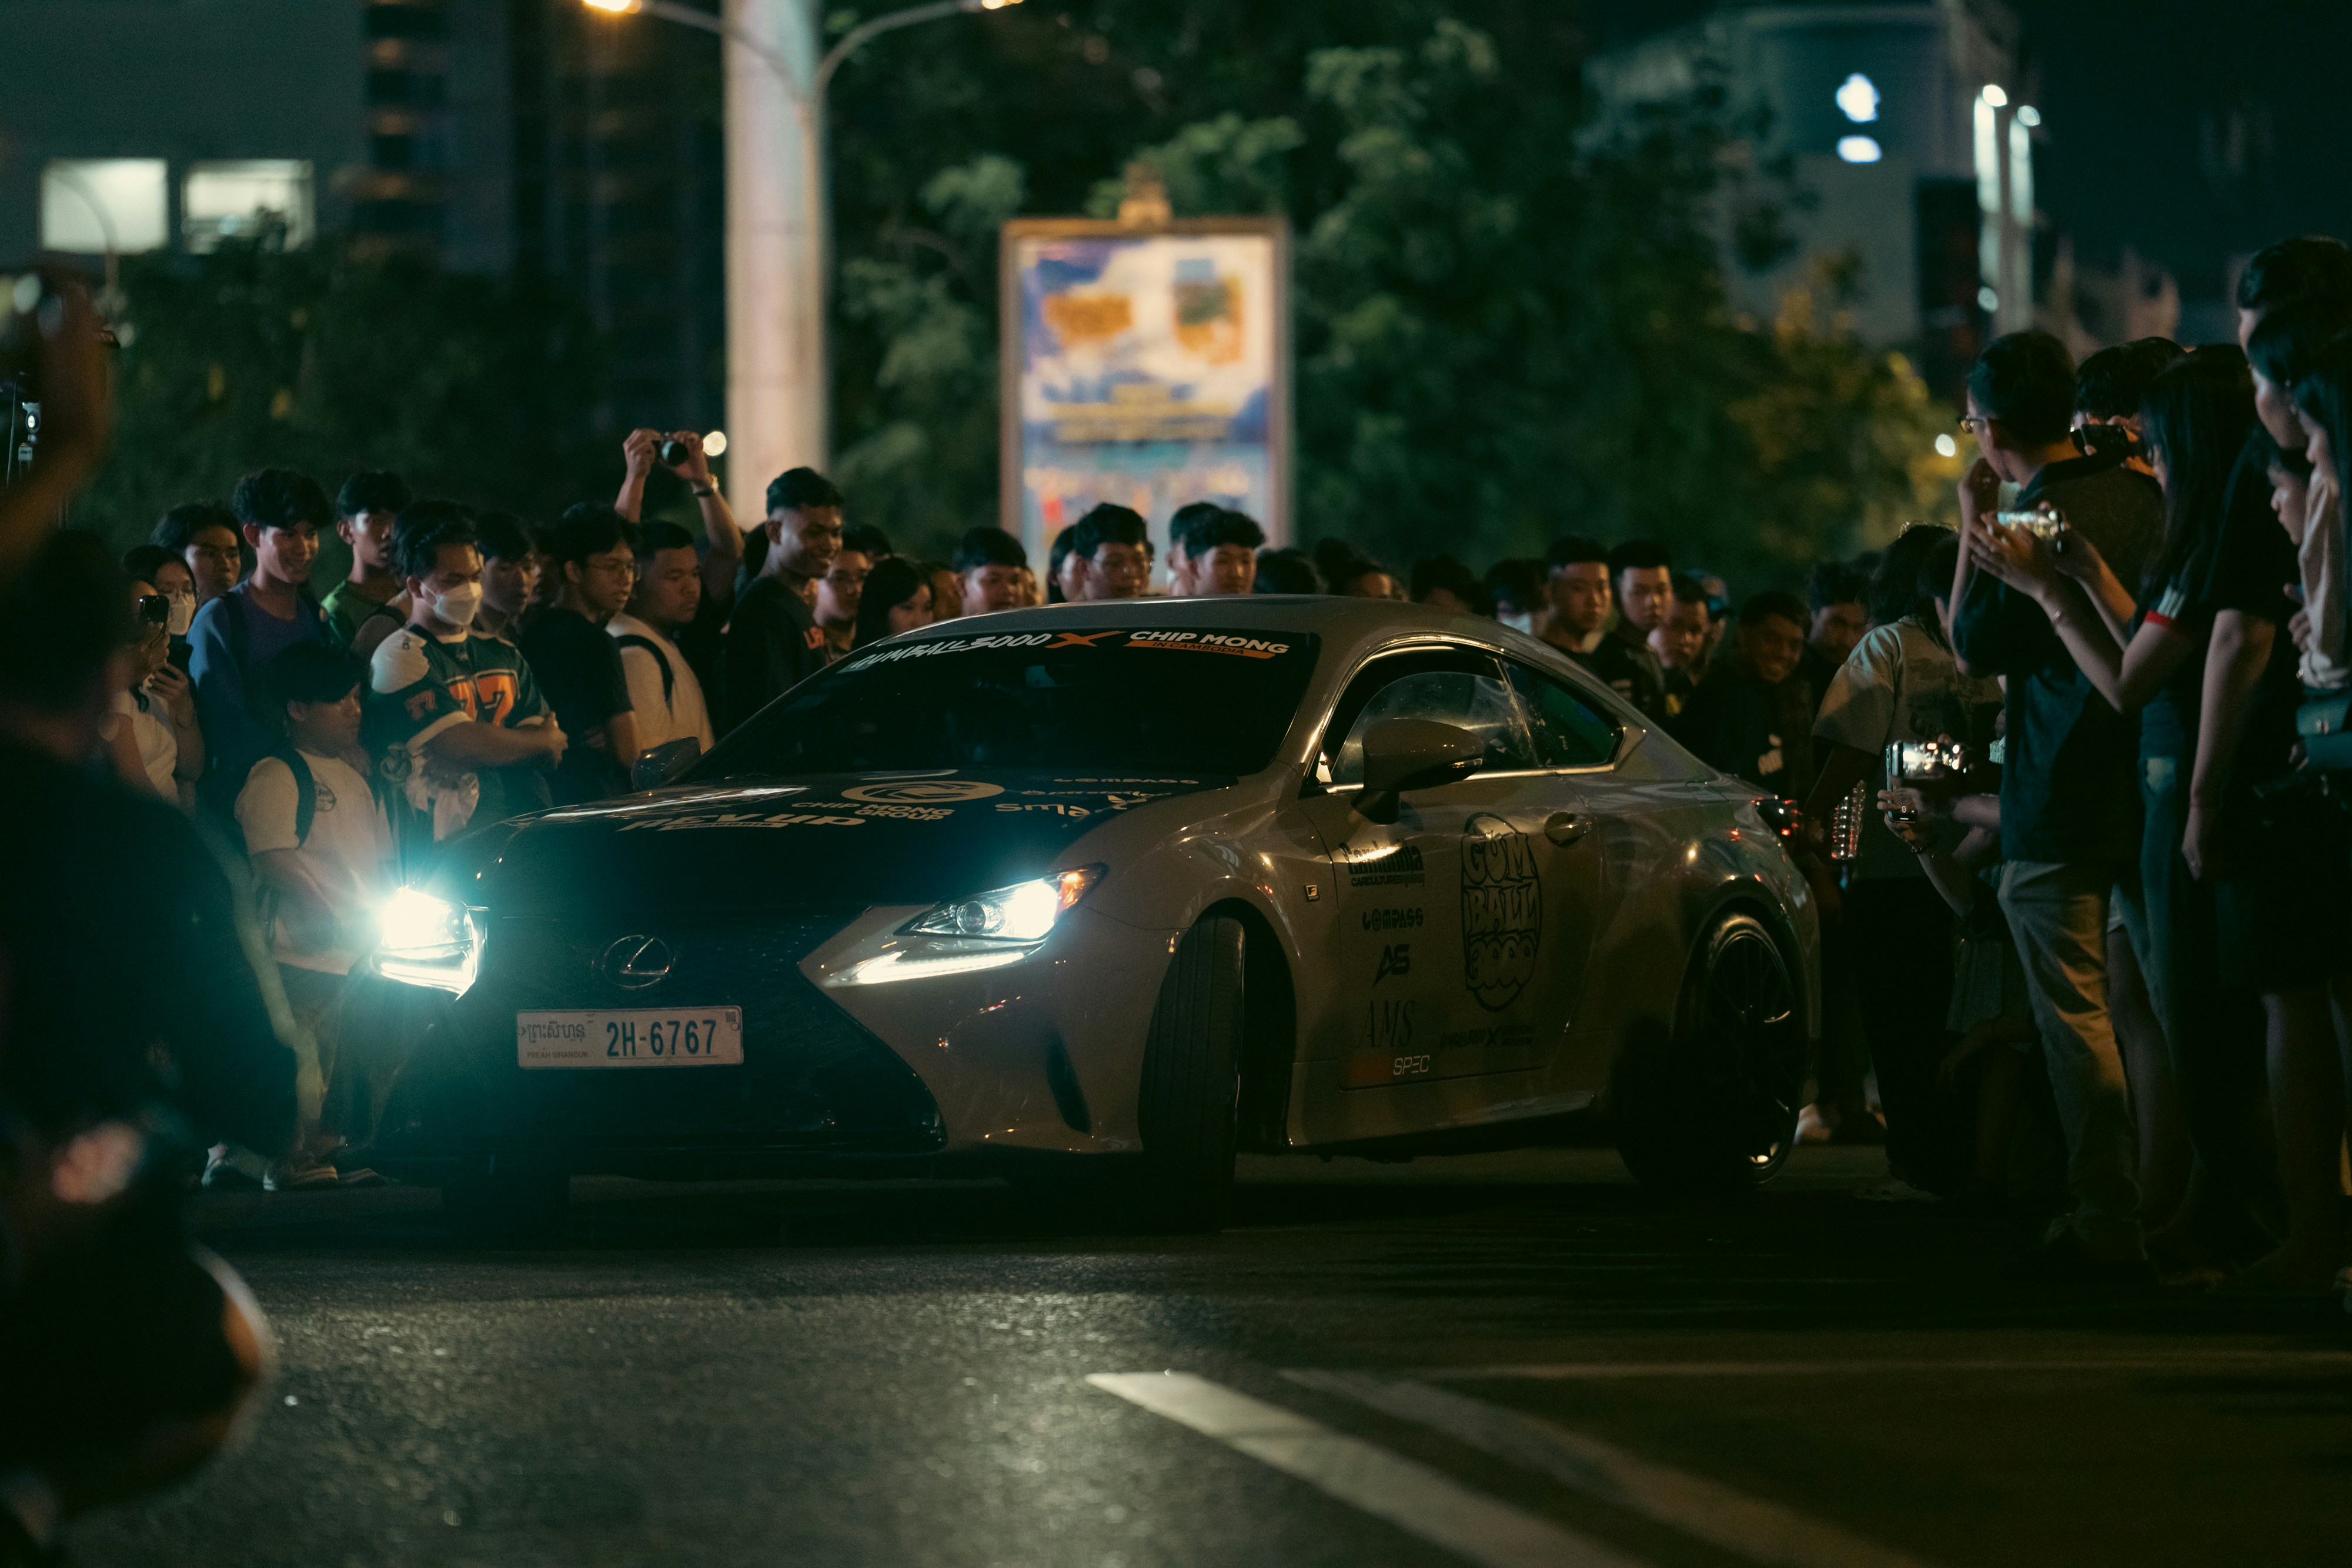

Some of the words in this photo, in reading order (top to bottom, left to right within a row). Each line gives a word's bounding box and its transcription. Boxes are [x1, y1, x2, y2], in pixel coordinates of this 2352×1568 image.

[1130, 631, 1198, 642] CHIP
[1199, 634, 1290, 654] MONG
[1169, 643, 1244, 654] CAMBODIA
[445, 669, 521, 727] 77
[854, 810, 945, 821] GROUP
[863, 804, 955, 816] MONG
[1462, 832, 1538, 885] GUM
[1351, 874, 1402, 887] CARCULTURES
[1362, 907, 1424, 931] COMPASS
[1464, 882, 1537, 938] BALL
[1466, 934, 1536, 990] 3000
[1357, 1000, 1415, 1048] AMS
[606, 1019, 716, 1057] 2H-6767
[1393, 1055, 1430, 1075] SPEC
